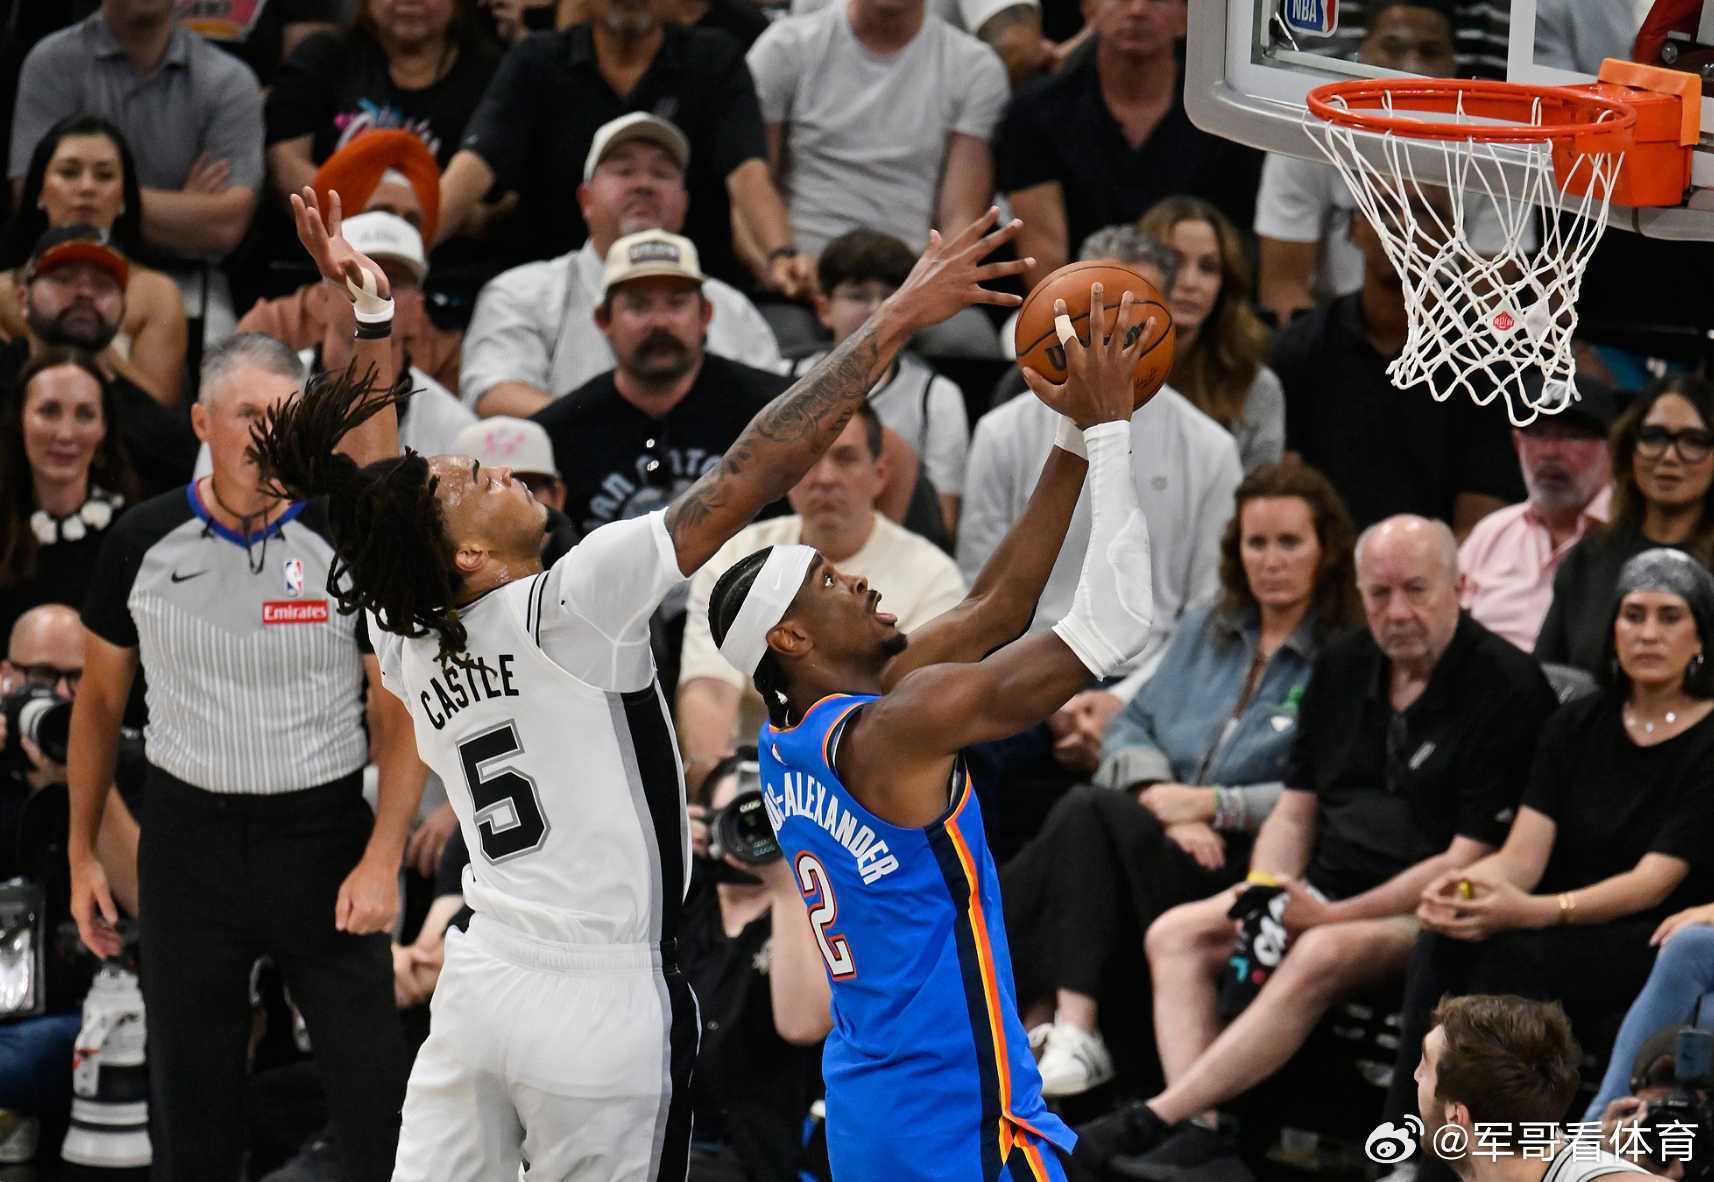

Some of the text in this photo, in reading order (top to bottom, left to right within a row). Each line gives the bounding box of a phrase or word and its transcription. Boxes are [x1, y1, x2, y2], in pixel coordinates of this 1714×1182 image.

[1292, 0, 1317, 23] NBA
[264, 605, 327, 621] Emirates
[420, 654, 519, 730] CASTLE
[455, 718, 551, 866] 5
[794, 850, 857, 981] 2
